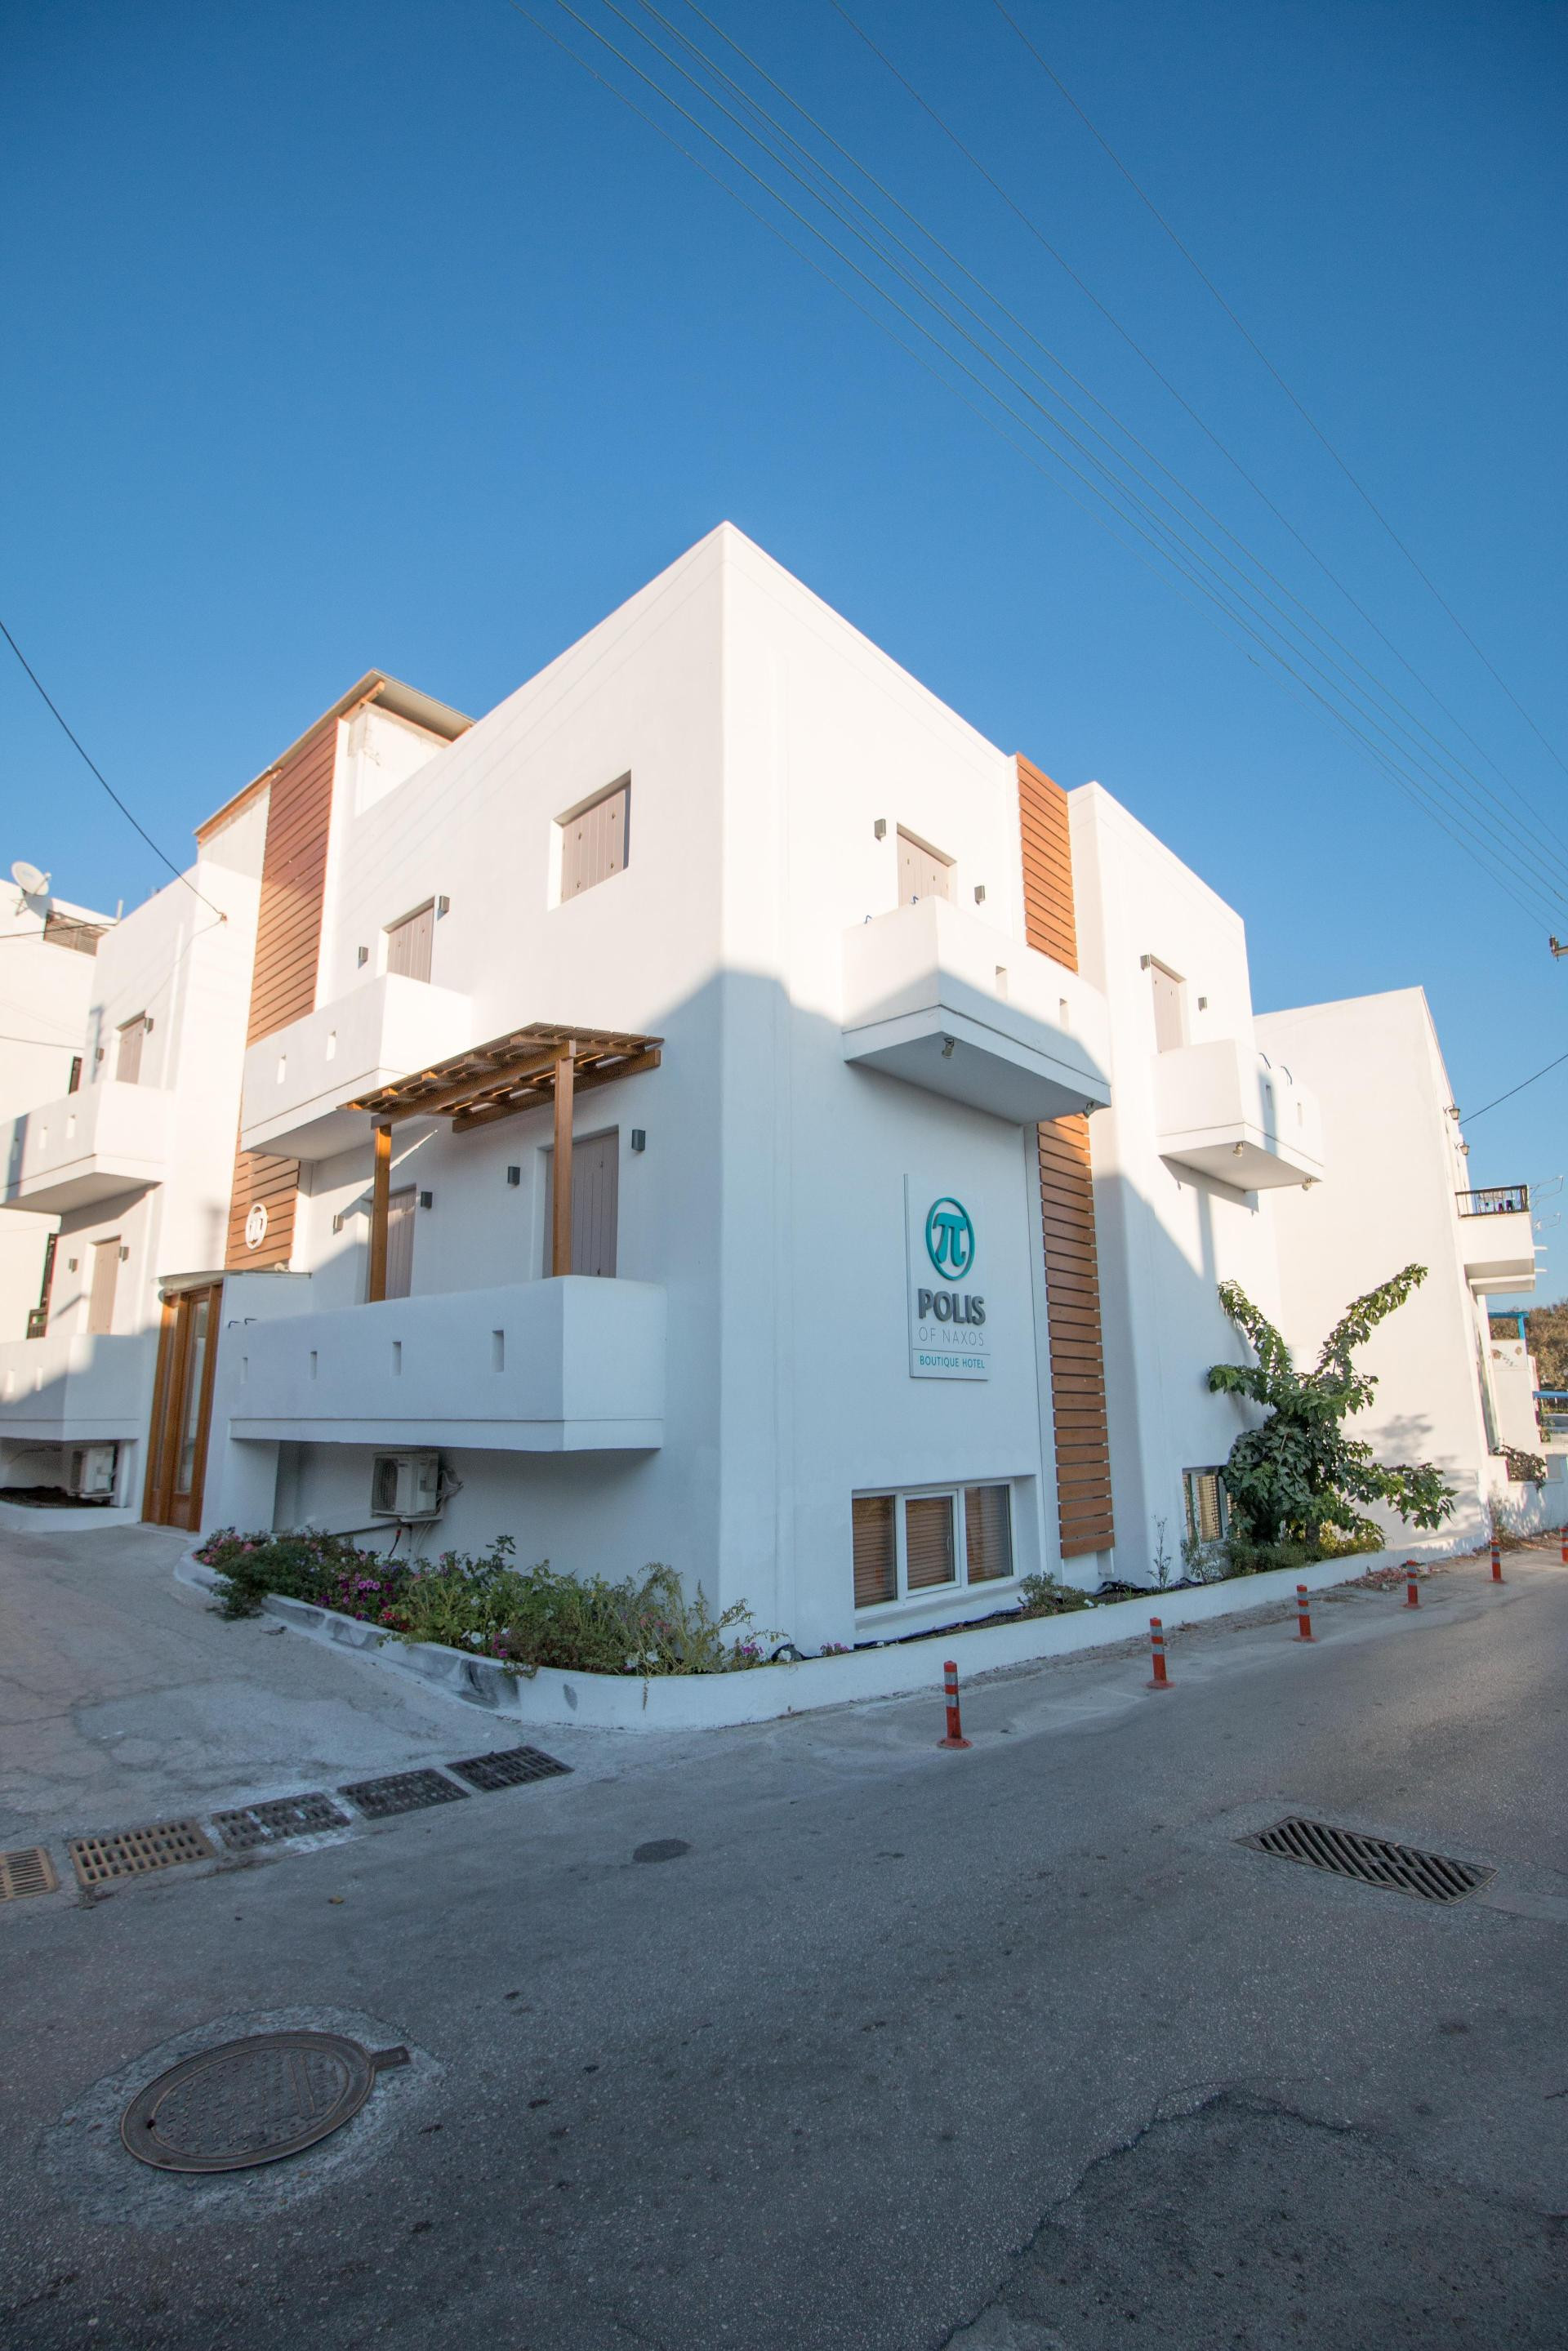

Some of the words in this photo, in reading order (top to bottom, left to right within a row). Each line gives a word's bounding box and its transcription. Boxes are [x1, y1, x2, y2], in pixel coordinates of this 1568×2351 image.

[918, 1289, 986, 1325] POLIS
[919, 1327, 936, 1343] OF
[942, 1329, 984, 1347] NAXOS
[920, 1356, 960, 1368] BOUTIQUE
[962, 1358, 985, 1369] HOTEL
